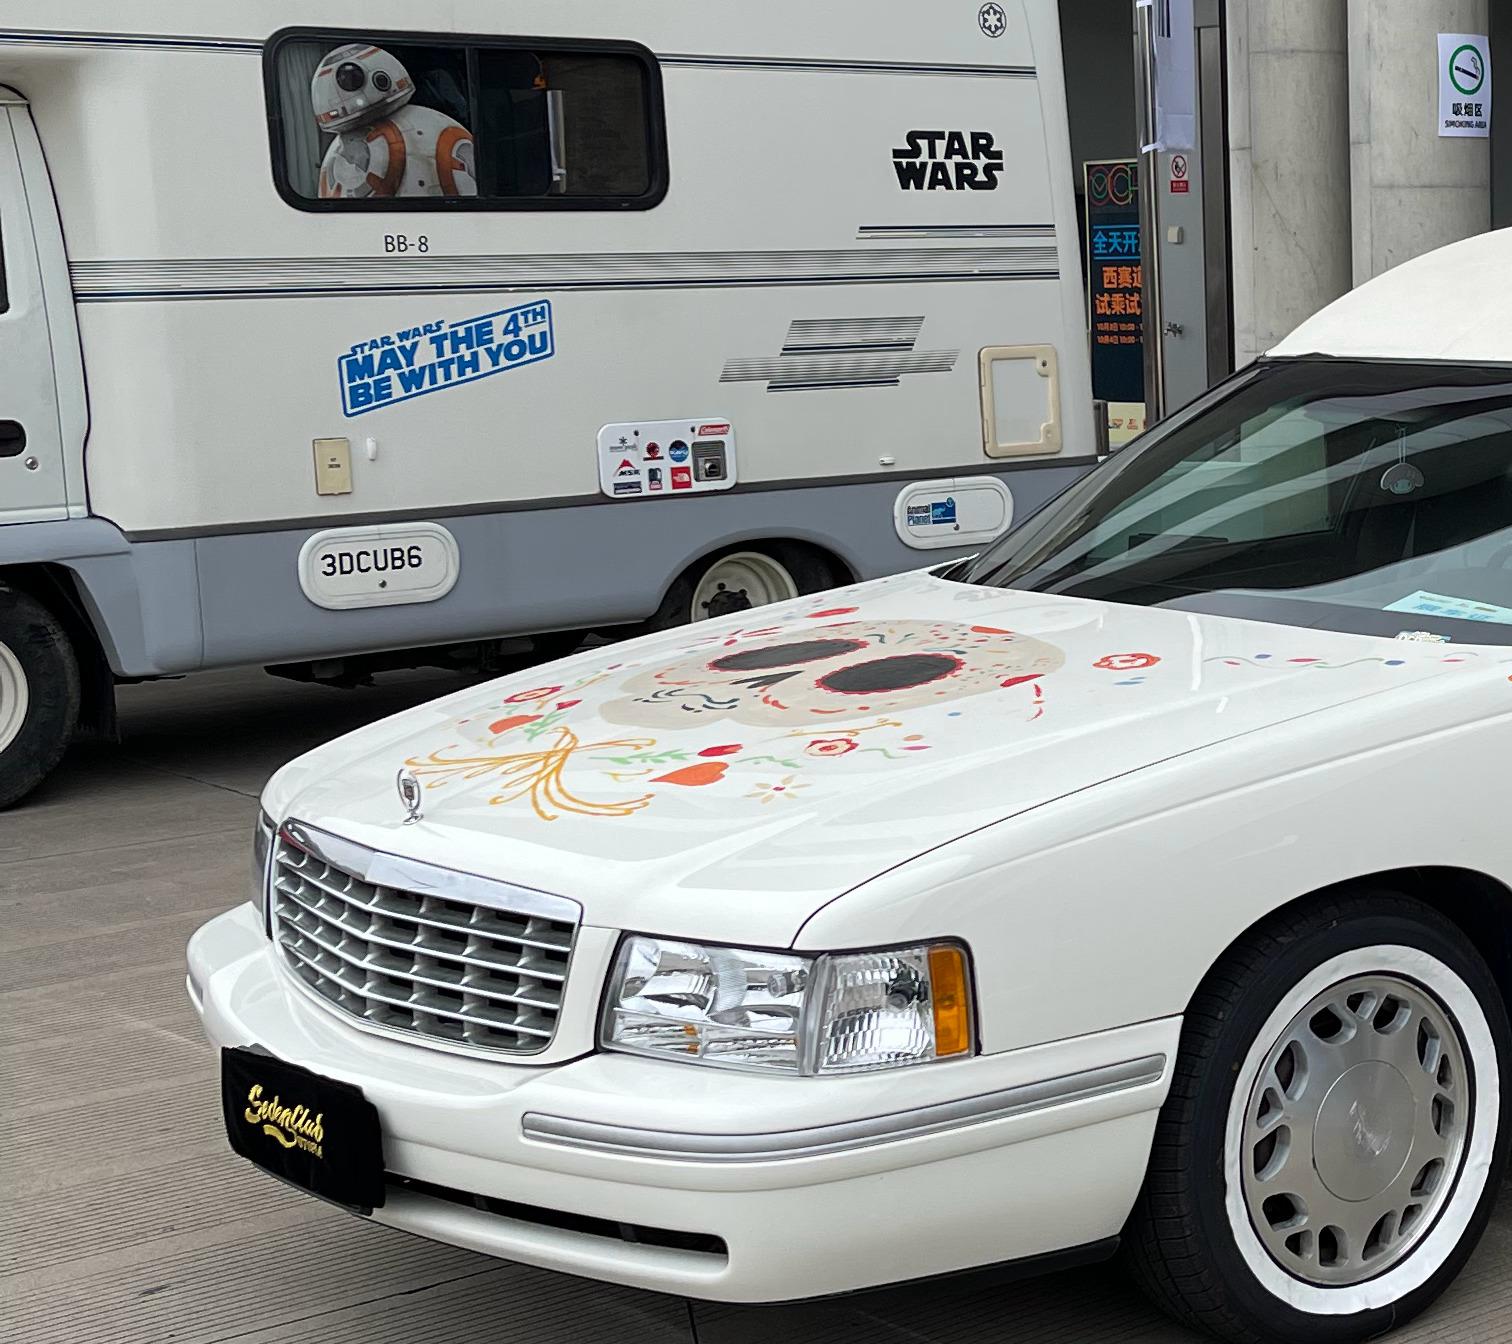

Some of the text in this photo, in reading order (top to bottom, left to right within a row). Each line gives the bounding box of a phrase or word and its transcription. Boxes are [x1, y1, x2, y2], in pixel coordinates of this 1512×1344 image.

[1445, 120, 1474, 128] SMOKING
[892, 130, 1003, 160] STAR
[893, 161, 1004, 190] WARS
[384, 234, 428, 253] BB-8
[1093, 231, 1142, 254] 全天开
[1095, 293, 1143, 316] 试乘试
[346, 305, 546, 383] MAY THE 4TH
[350, 319, 445, 356] STAR WARS
[348, 330, 548, 409] BE WITH YOU
[321, 545, 422, 576] 3DCUB6
